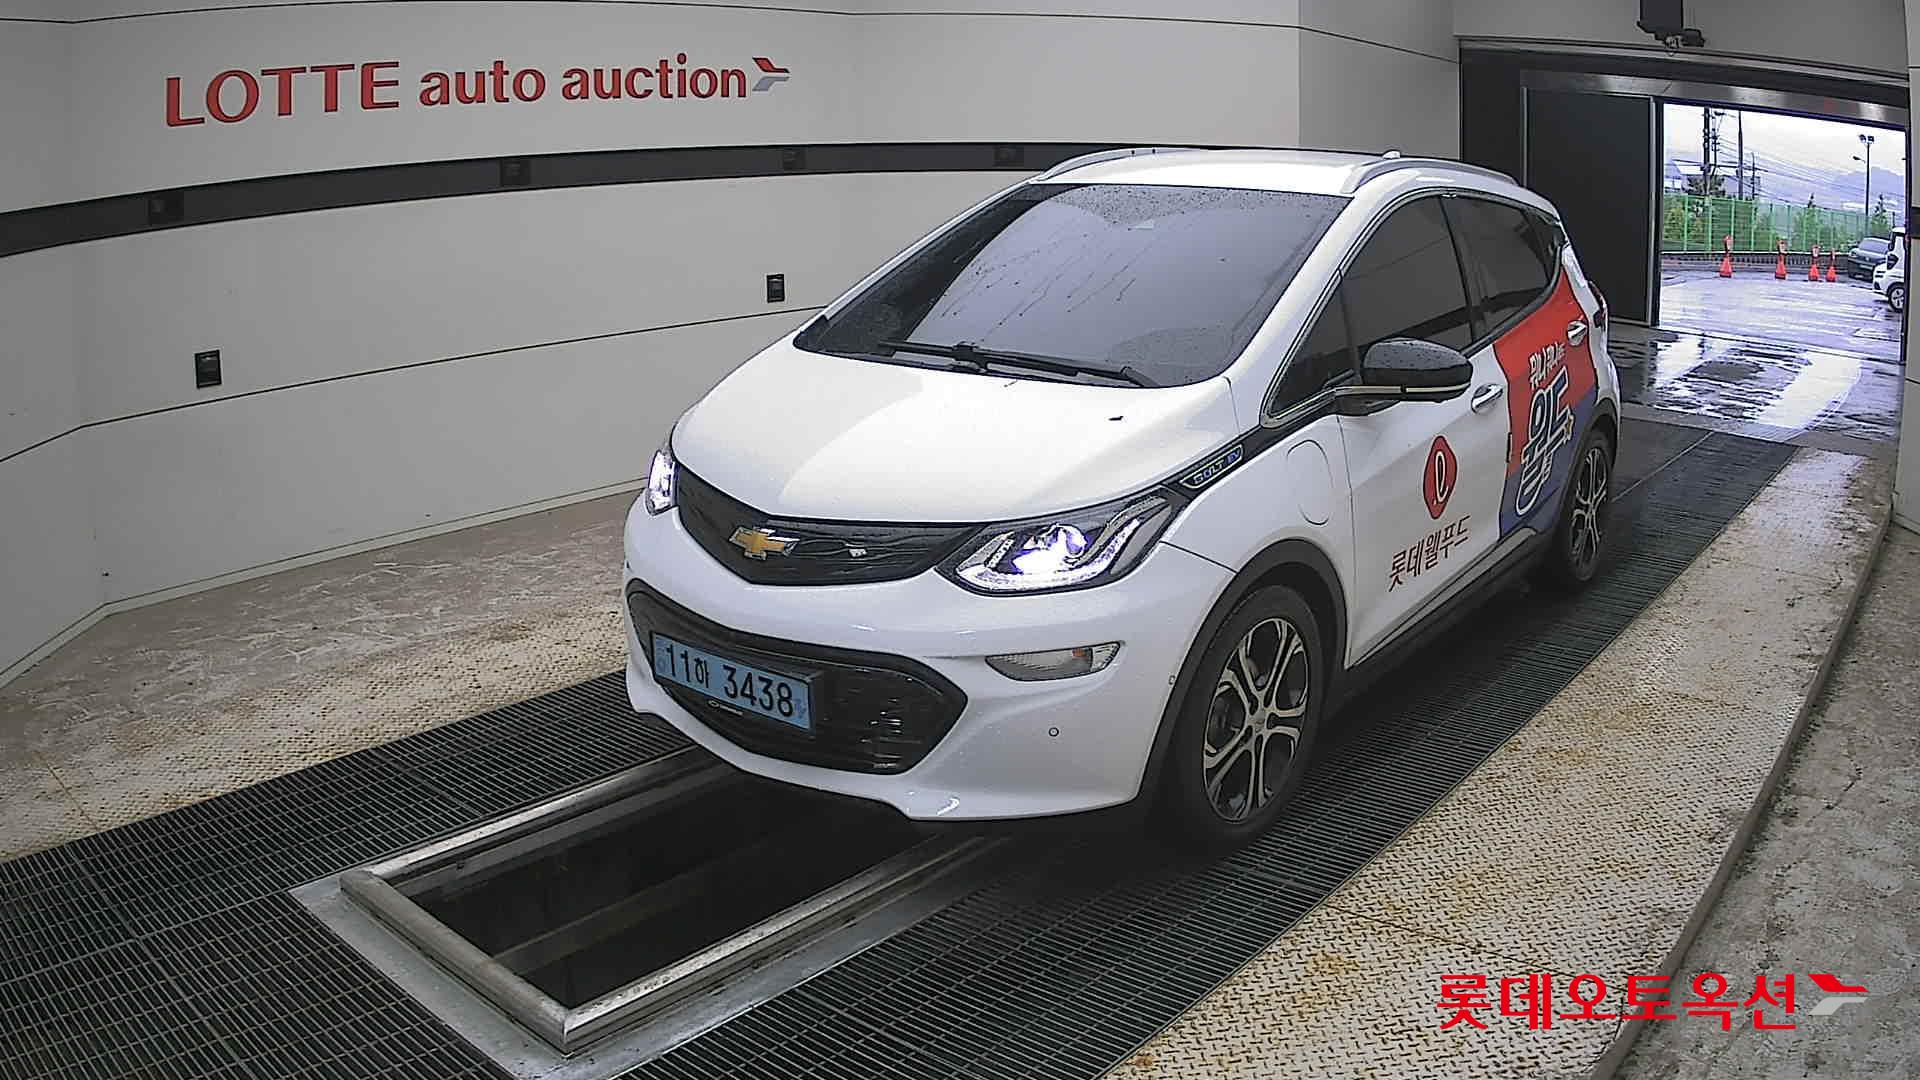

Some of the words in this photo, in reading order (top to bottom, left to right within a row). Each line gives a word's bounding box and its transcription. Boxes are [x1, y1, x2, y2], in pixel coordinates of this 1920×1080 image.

[166, 61, 400, 127] LOTTE
[418, 60, 546, 106] auto
[561, 52, 747, 101] auction
[1388, 514, 1472, 593] 롯데웰푸드
[665, 643, 710, 689] 11하
[721, 663, 794, 718] 3438
